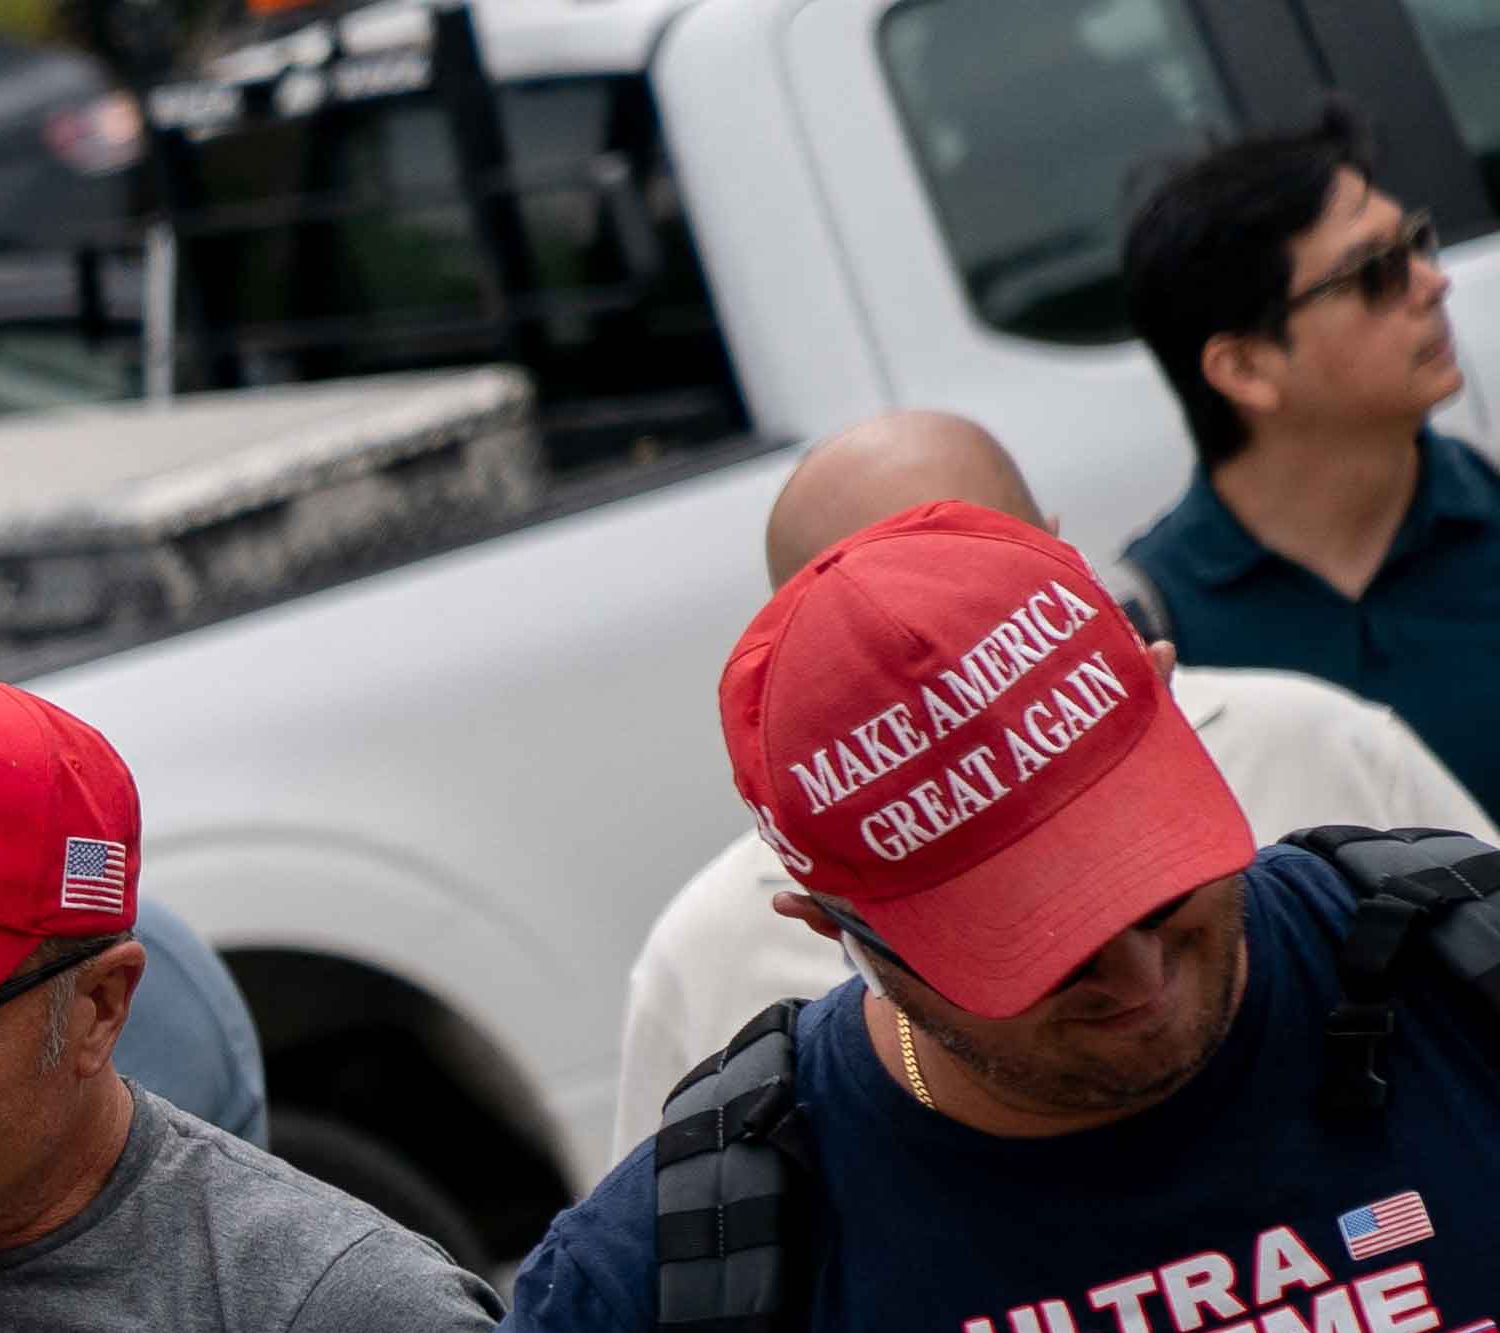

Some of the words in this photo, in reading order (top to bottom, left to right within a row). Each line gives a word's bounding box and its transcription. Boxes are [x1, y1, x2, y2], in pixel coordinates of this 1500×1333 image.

[789, 702, 931, 816] MAKE
[920, 580, 1099, 740] AMERICA
[860, 744, 1012, 863] GREAT
[1003, 651, 1130, 782] AGAIN
